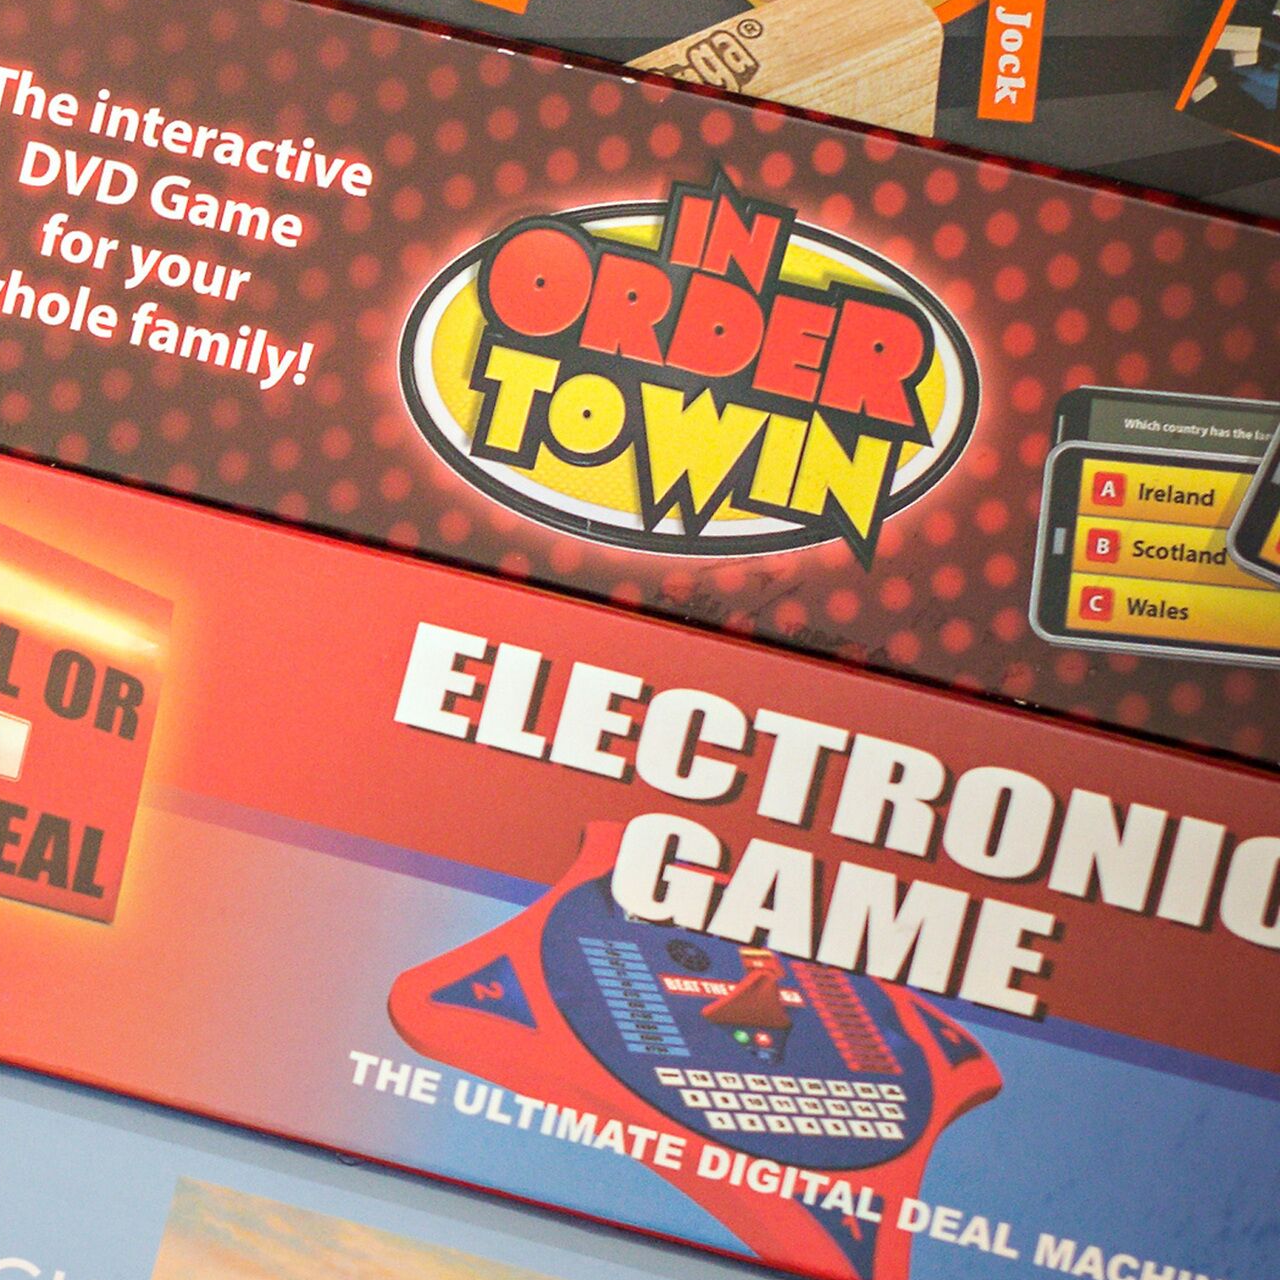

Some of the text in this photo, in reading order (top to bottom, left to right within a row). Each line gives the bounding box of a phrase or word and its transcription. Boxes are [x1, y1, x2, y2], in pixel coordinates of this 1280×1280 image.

[992, 7, 1034, 106] Jock
[88, 88, 375, 197] interactive
[18, 141, 304, 248] DVD Game
[669, 190, 783, 297] IN
[40, 213, 252, 301] for your
[129, 302, 315, 390] family!
[486, 226, 927, 427] ORDER
[484, 345, 893, 541] TO WIN
[1124, 418, 1254, 440] Which country has the
[1138, 483, 1215, 508] Ireland
[1132, 540, 1228, 567] Scotland
[1127, 597, 1189, 621] Wales
[42, 648, 146, 742] OR
[610, 811, 1057, 1018] GAME
[349, 1048, 443, 1108] THE
[452, 1074, 690, 1171] ULTIMATE
[696, 1145, 884, 1225] DIGITAL
[897, 1197, 1020, 1262] DEAL
